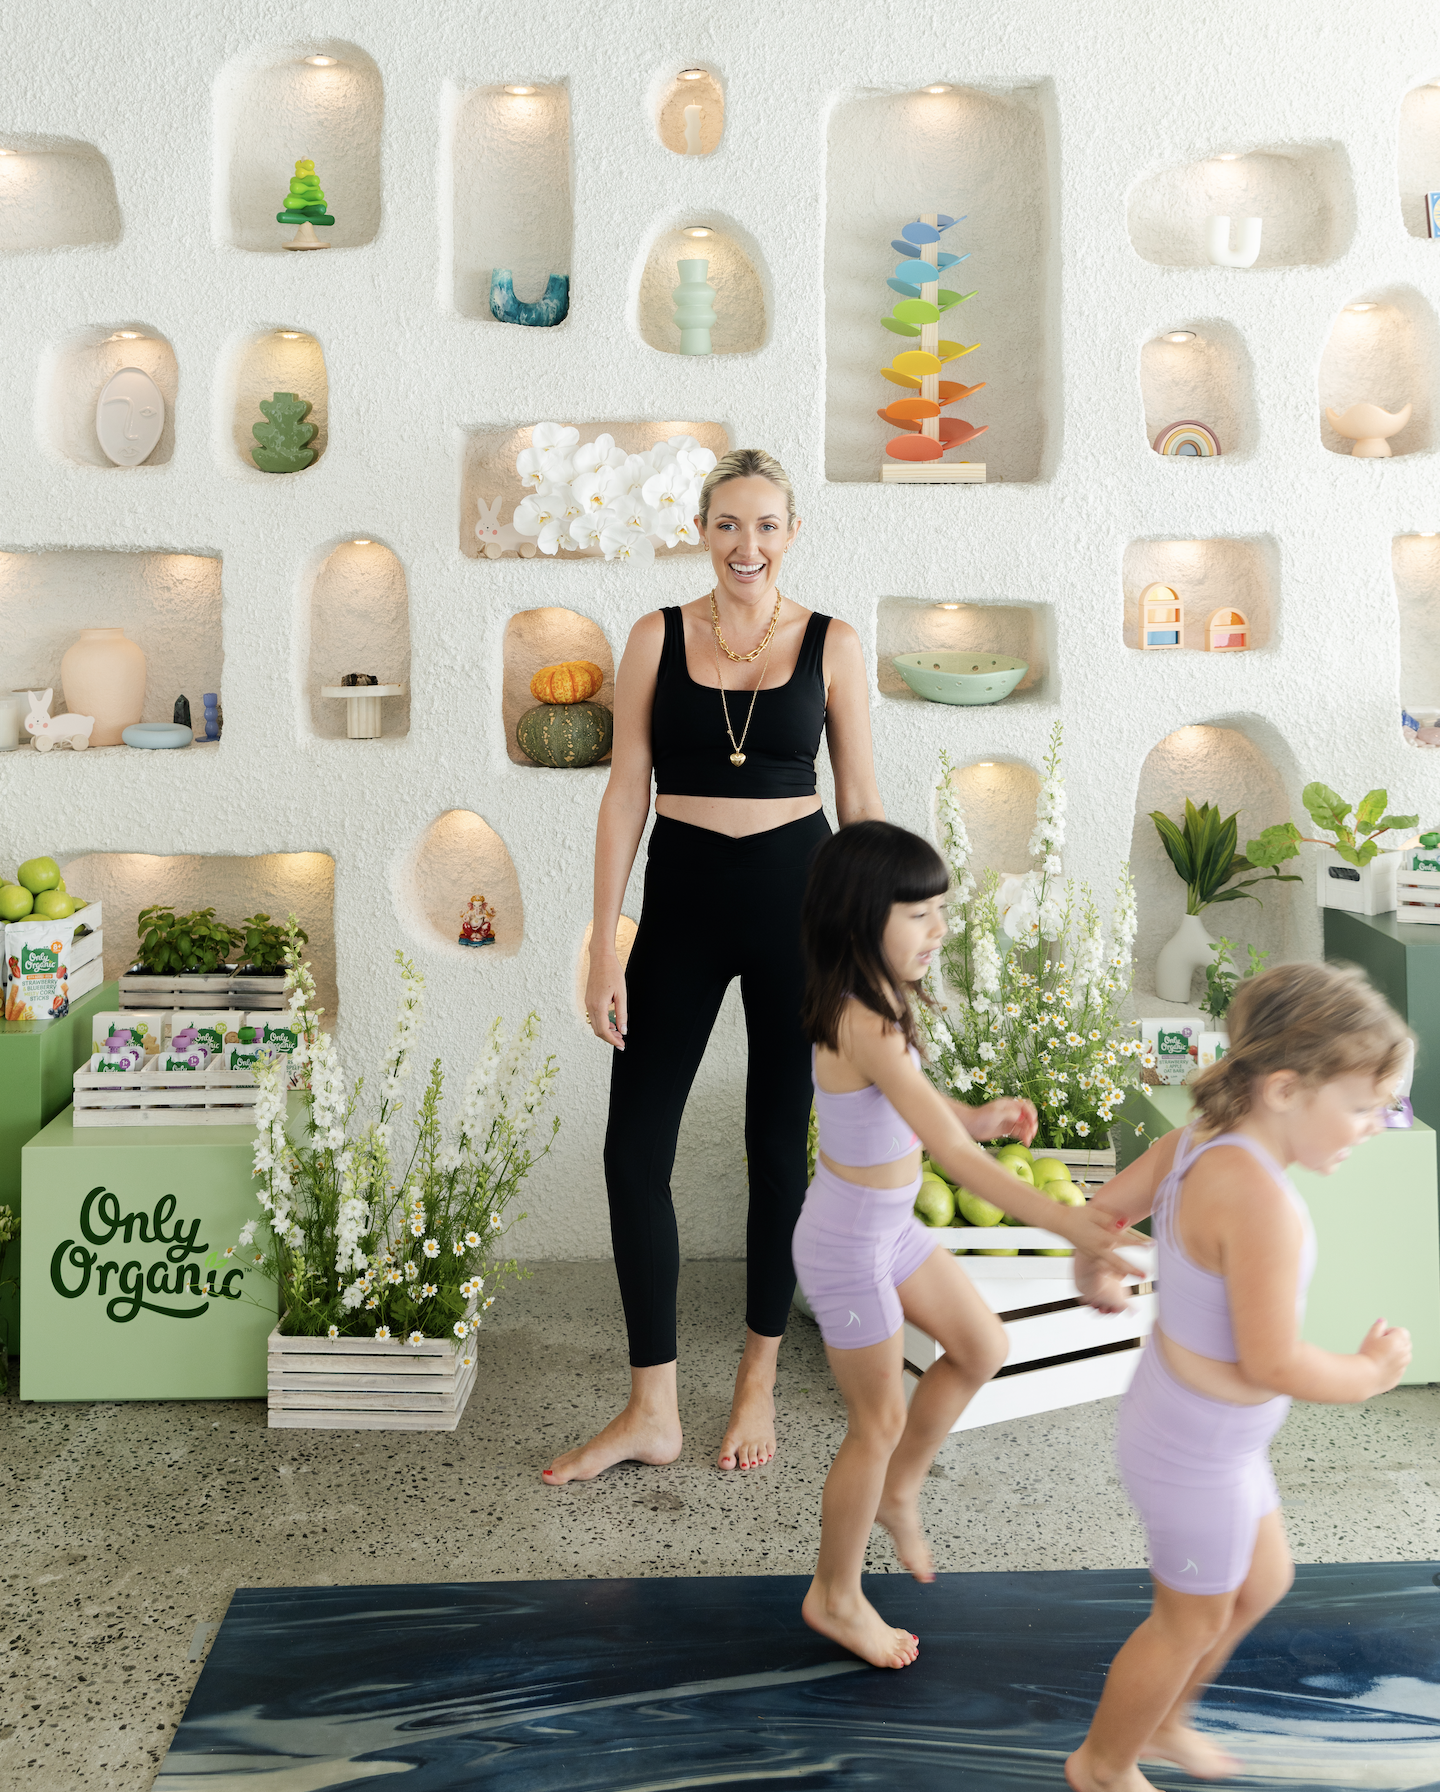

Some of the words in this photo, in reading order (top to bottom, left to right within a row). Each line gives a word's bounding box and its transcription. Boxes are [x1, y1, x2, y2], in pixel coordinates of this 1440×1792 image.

[29, 952, 50, 963] Only
[25, 960, 56, 973] Organic
[270, 1032, 289, 1043] Only
[1164, 1036, 1181, 1046] Only
[1161, 1042, 1186, 1053] Organic
[80, 1186, 209, 1263] Only
[50, 1239, 244, 1323] Organic
